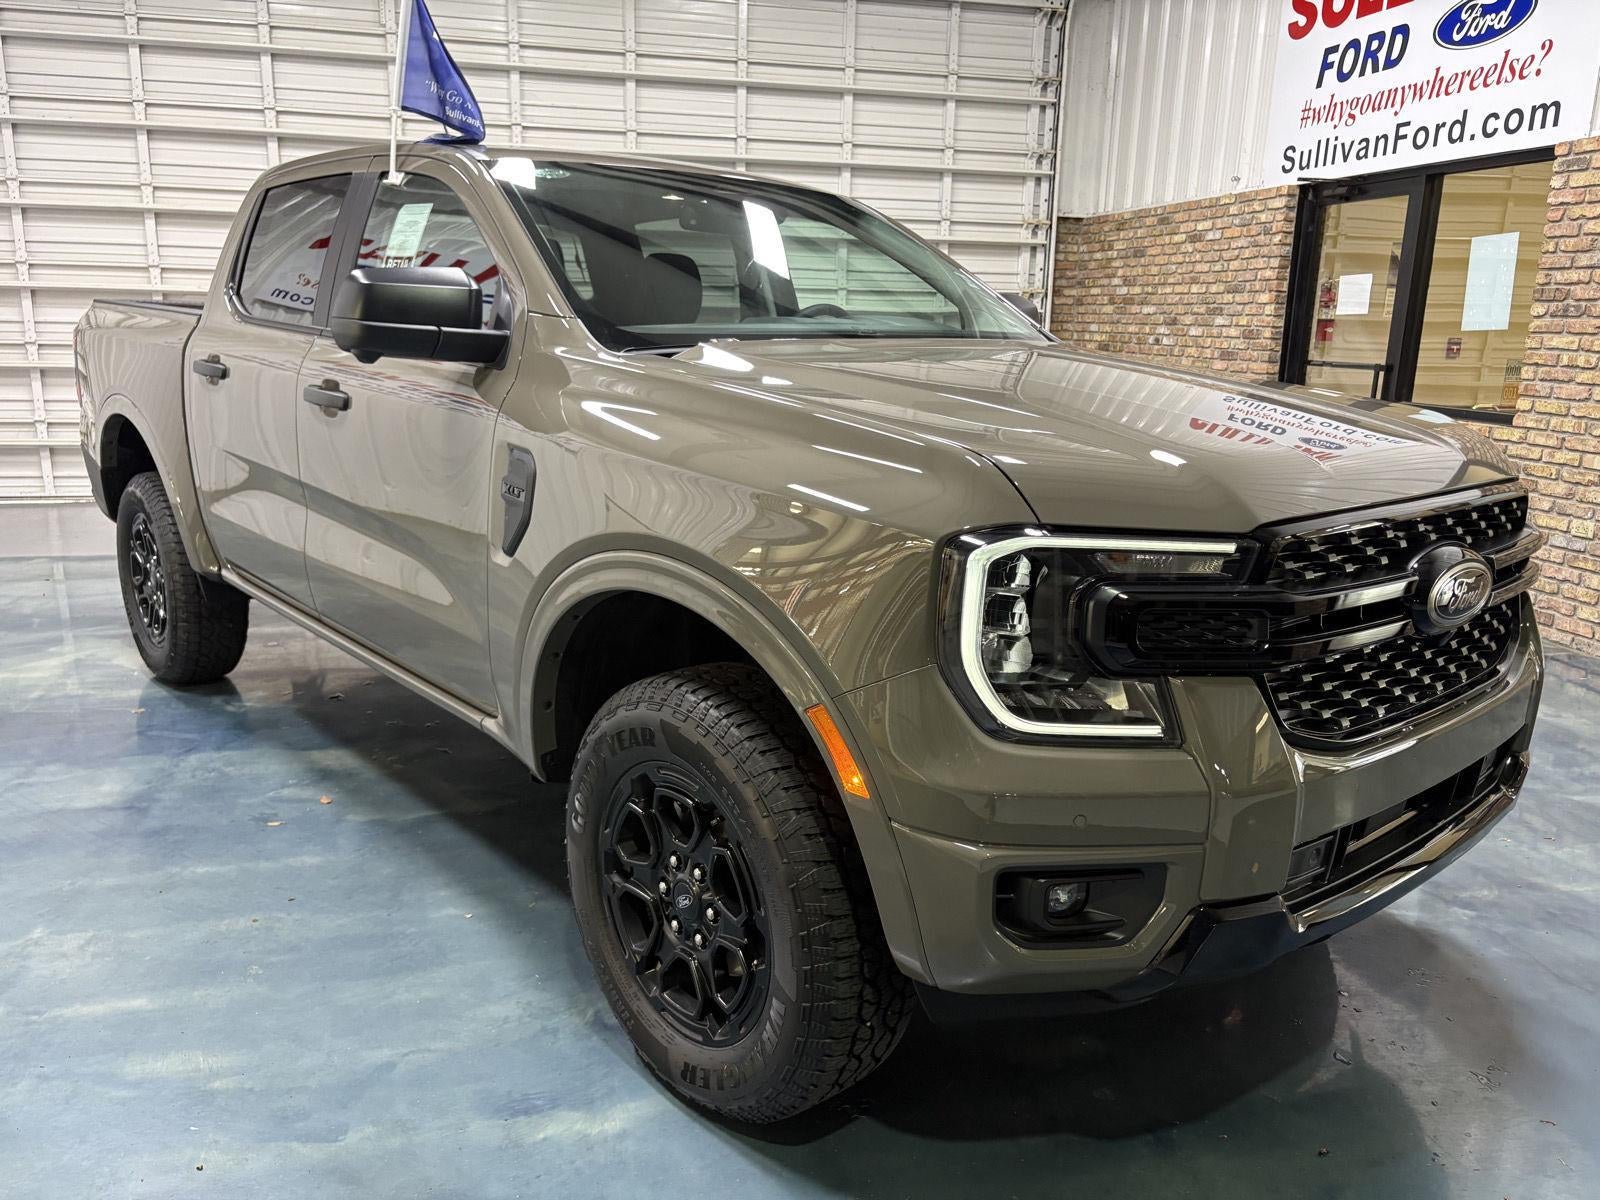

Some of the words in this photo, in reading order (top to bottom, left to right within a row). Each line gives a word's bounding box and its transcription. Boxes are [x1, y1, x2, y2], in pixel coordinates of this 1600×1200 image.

[1452, 0, 1516, 42] Ford
[1315, 23, 1411, 89] FORD
[1298, 38, 1554, 130] #whygoanywhereelse?
[1281, 100, 1562, 174] SullivanFord.com
[503, 482, 525, 499] XLT
[1448, 576, 1485, 614] Ford
